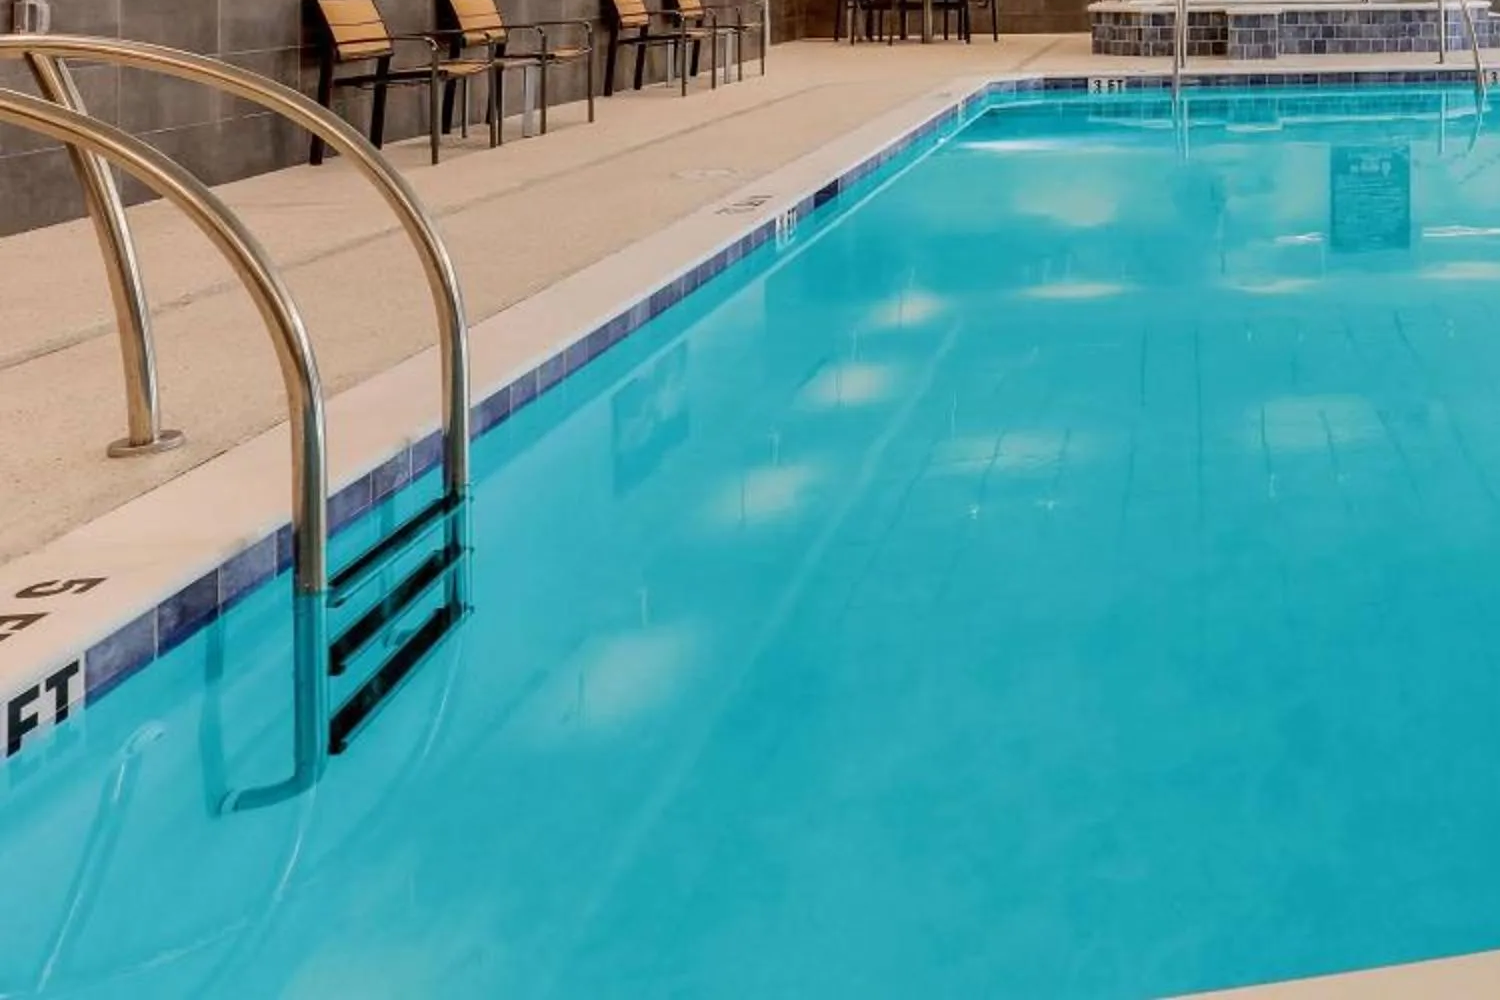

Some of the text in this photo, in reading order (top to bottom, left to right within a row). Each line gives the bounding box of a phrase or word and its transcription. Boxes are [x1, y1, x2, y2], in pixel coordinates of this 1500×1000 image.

[1093, 79, 1123, 94] 3 FT
[15, 577, 107, 599] 5
[7, 659, 80, 758] FT
